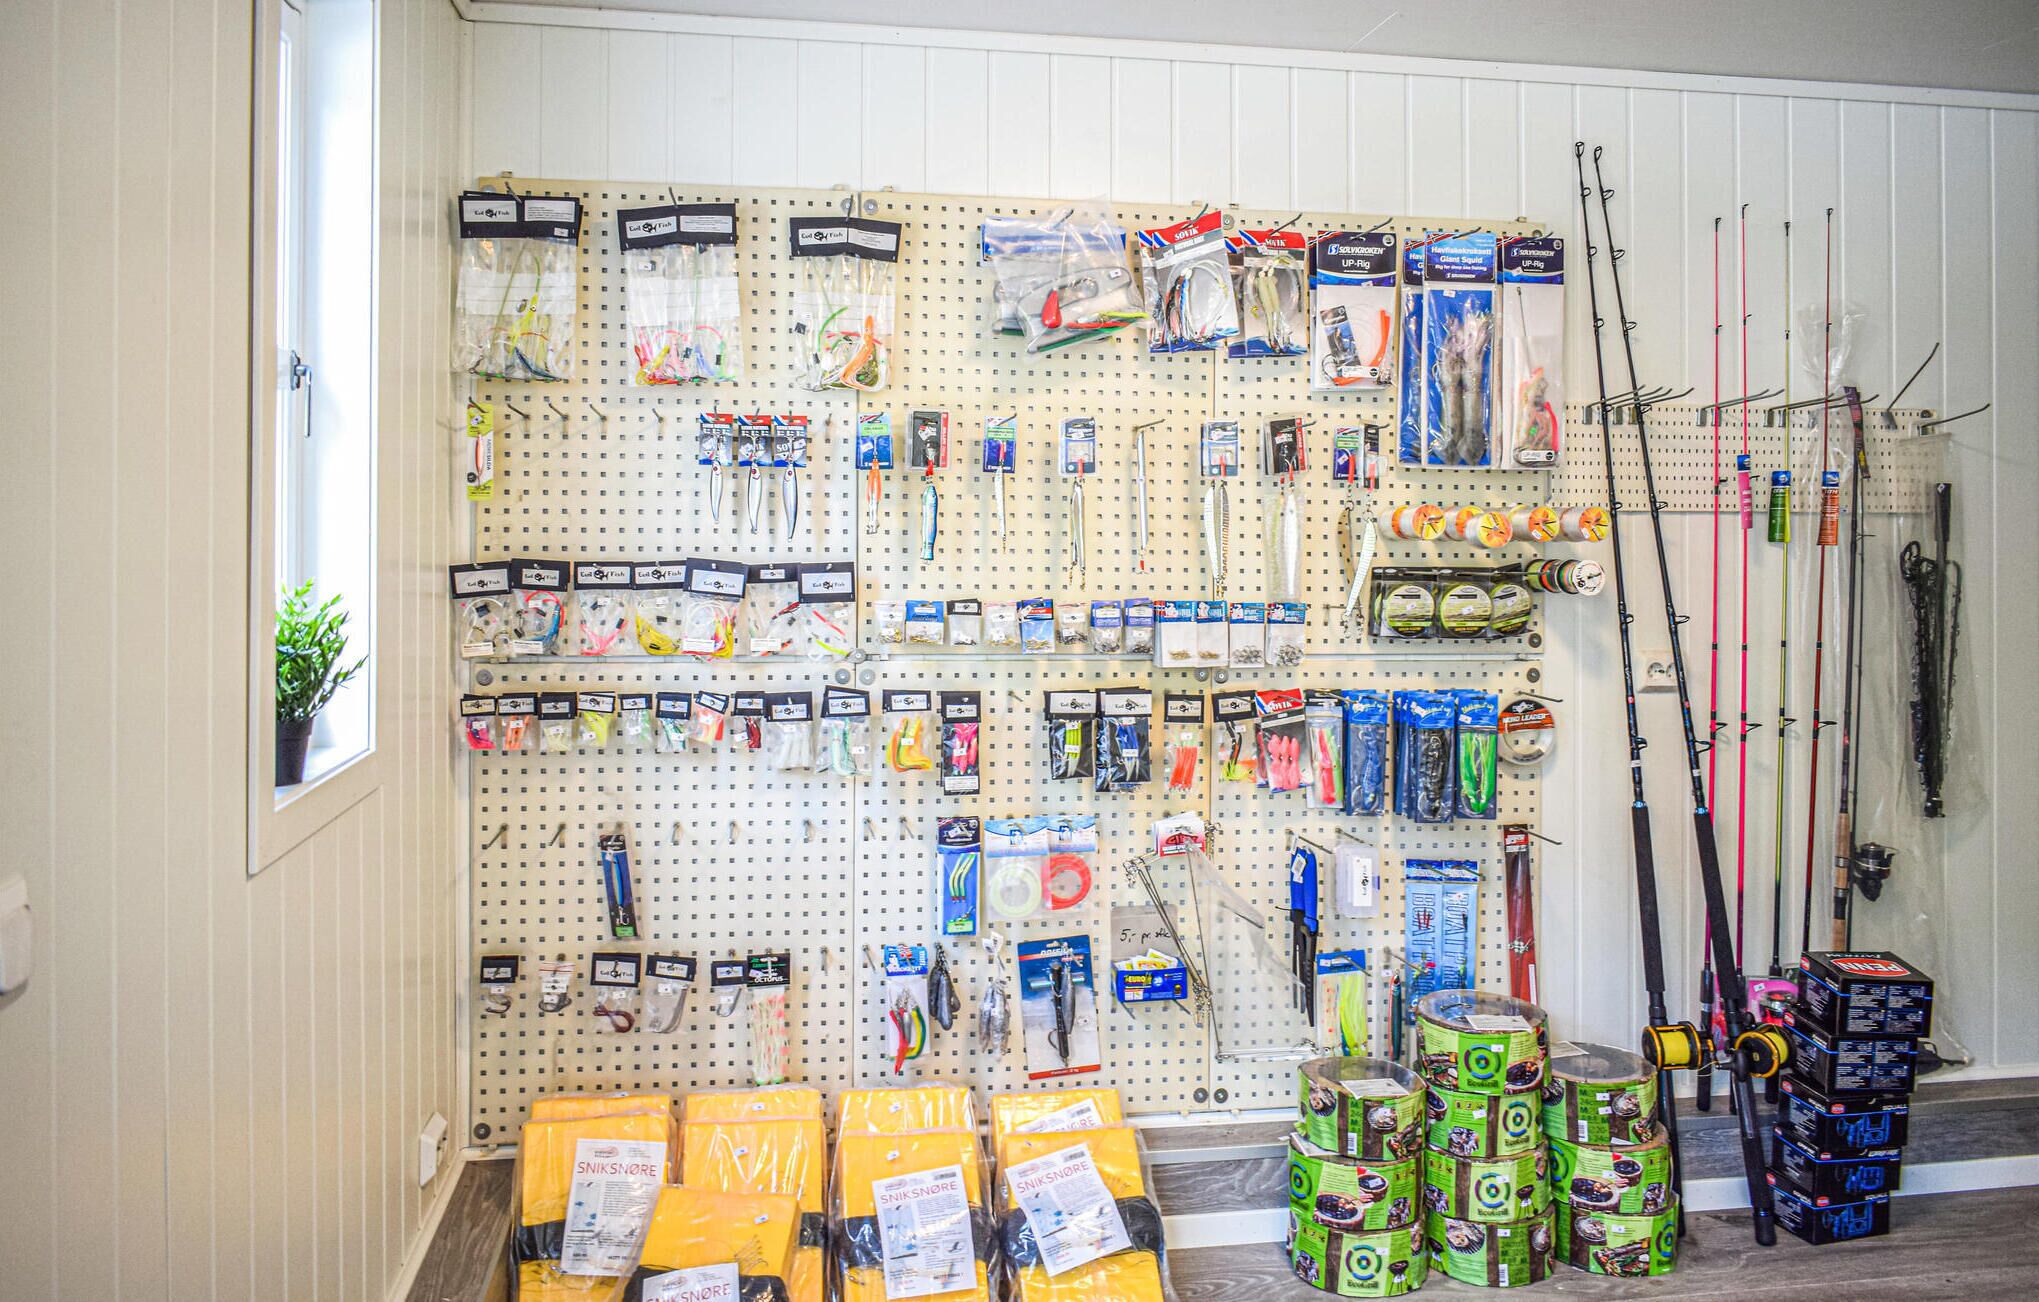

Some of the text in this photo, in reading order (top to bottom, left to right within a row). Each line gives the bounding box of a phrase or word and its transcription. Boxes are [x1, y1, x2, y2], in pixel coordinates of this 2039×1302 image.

[1338, 246, 1383, 254] SØLVKROKEN
[1342, 259, 1370, 269] UP-Rig
[1462, 256, 1482, 264] Squid
[1522, 260, 1543, 268] UP-Rig
[1839, 962, 1902, 972] PENN
[577, 1162, 656, 1176] SNIKSNØRE
[1017, 1161, 1089, 1194] SNIKSNØRE
[880, 1181, 958, 1204] SNIKSNØRE
